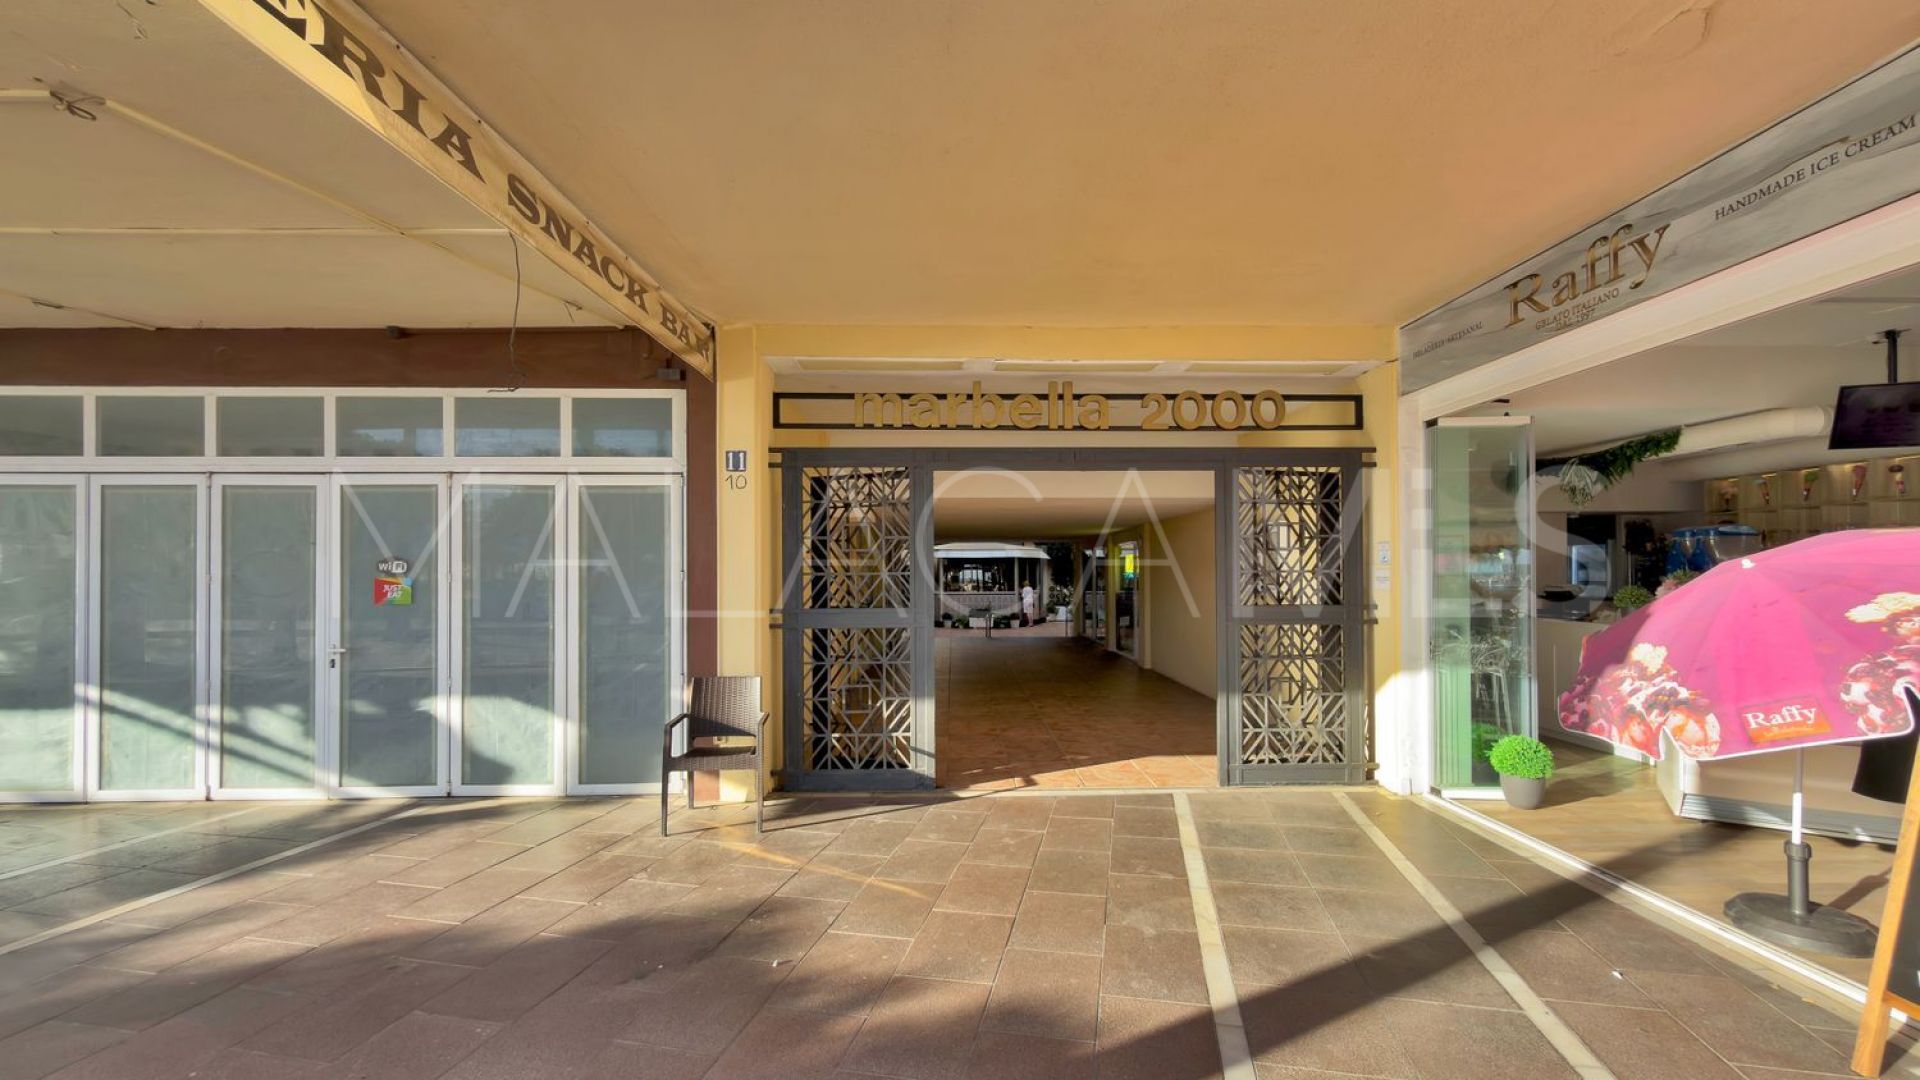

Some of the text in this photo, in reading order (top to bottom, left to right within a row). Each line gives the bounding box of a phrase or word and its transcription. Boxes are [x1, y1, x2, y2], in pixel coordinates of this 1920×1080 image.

[1714, 114, 1917, 220] HANDMADE ICE CREAM
[507, 173, 650, 315] SNACK
[1503, 223, 1671, 329] Raffy
[1571, 287, 1620, 316] ITALIANO
[853, 380, 1287, 431] marbella 2000
[727, 452, 746, 471] 11
[724, 474, 748, 490] 10
[1742, 704, 1817, 729] Raffy
